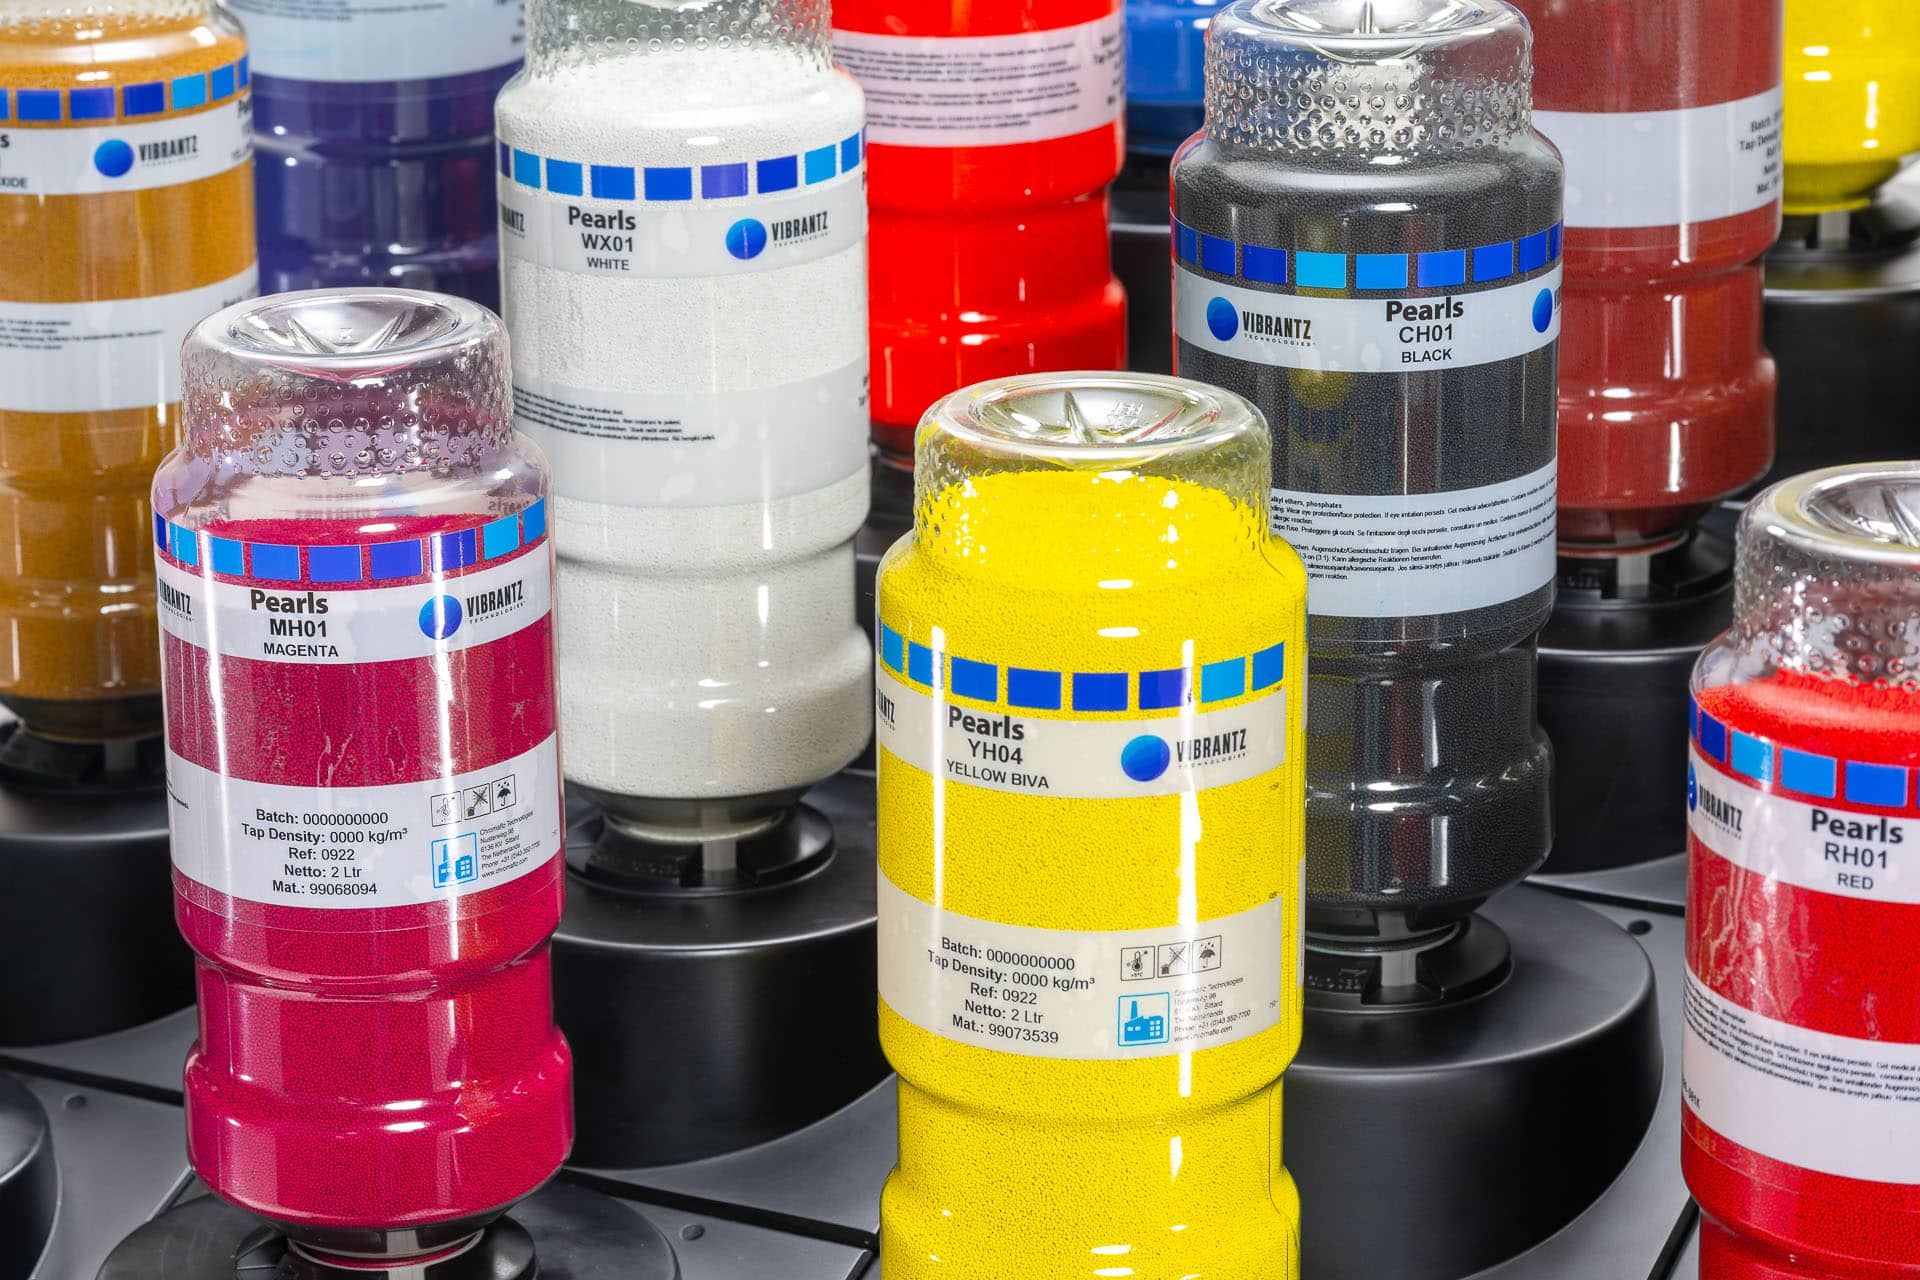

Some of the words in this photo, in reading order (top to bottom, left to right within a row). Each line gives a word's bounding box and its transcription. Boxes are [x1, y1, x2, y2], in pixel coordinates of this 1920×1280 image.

[139, 135, 198, 162] VIBRANTZ
[568, 206, 636, 231] Pearls
[772, 211, 828, 242] VIBRANTZ
[581, 232, 634, 252] WX01
[586, 256, 630, 271] WHITE
[1386, 297, 1464, 322] Pearls
[1242, 311, 1312, 340] VIBRANTZ
[1399, 323, 1453, 344] CH01
[1401, 348, 1452, 363] BLACK
[250, 590, 328, 614] Pearls
[466, 580, 523, 618] VIBRANTZ
[270, 618, 327, 638] MH01
[264, 642, 339, 657] MAGENTA
[949, 704, 1024, 740] Pearls
[968, 738, 1023, 765] YH04
[1176, 728, 1246, 762] VIBRANTZ
[946, 759, 1007, 784] YELLOW
[1011, 773, 1050, 789] BIVA
[256, 808, 298, 824] Batch:
[302, 812, 389, 826] 0000000000
[1700, 784, 1742, 832] VIBRANTZ
[241, 823, 264, 840] Tap
[268, 828, 326, 845] Density:
[330, 831, 364, 844] 0000
[368, 828, 408, 845] kg/m³
[1811, 808, 1904, 844] Pearls
[288, 847, 316, 860] Ref:
[321, 848, 355, 861] 0922
[1824, 842, 1888, 870] RH01
[284, 864, 326, 878] Netto:
[331, 866, 339, 878] 2
[344, 866, 362, 878] Ltr
[1838, 872, 1874, 890] RED
[272, 880, 304, 894] Mat.:
[310, 883, 378, 896] 99068094
[942, 936, 982, 959] Batch:
[986, 948, 1076, 970] 0000000000
[928, 950, 948, 970] Tap
[952, 958, 1008, 984] Density:
[1012, 972, 1048, 988] 0000
[1052, 976, 1096, 992] kg/m³
[970, 982, 998, 1000] Ref:
[1002, 988, 1038, 1005] 0922
[964, 999, 1006, 1020] Netto:
[1011, 1008, 1019, 1022] 2
[1024, 1010, 1044, 1024] Ltr
[952, 1014, 984, 1034] Mat.:
[988, 1024, 1059, 1044] 99073539
